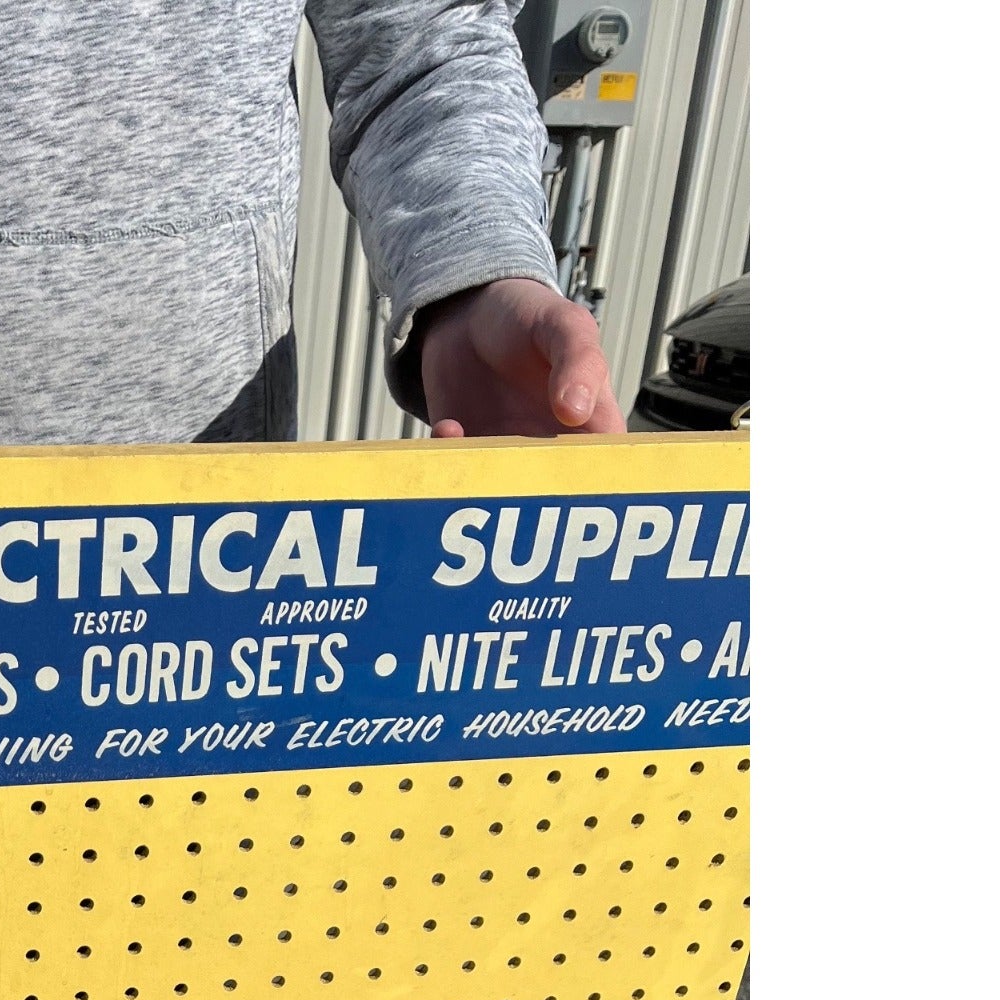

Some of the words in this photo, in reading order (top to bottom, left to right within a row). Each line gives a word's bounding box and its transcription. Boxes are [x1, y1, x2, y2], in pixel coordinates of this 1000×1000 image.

[432, 503, 751, 588] SUPPLI
[73, 609, 149, 636] TESTED
[260, 597, 368, 627] APPROVED
[489, 595, 572, 624] QUALITY
[81, 639, 213, 708] CORD
[226, 631, 348, 700] SETS
[417, 630, 529, 694] NITE
[541, 622, 673, 688] LITES
[708, 620, 751, 680] A
[95, 727, 170, 761] FOR
[179, 719, 275, 753] YOUR
[286, 712, 445, 750] ELECTRIC
[462, 703, 646, 741] HOUSEHOLD
